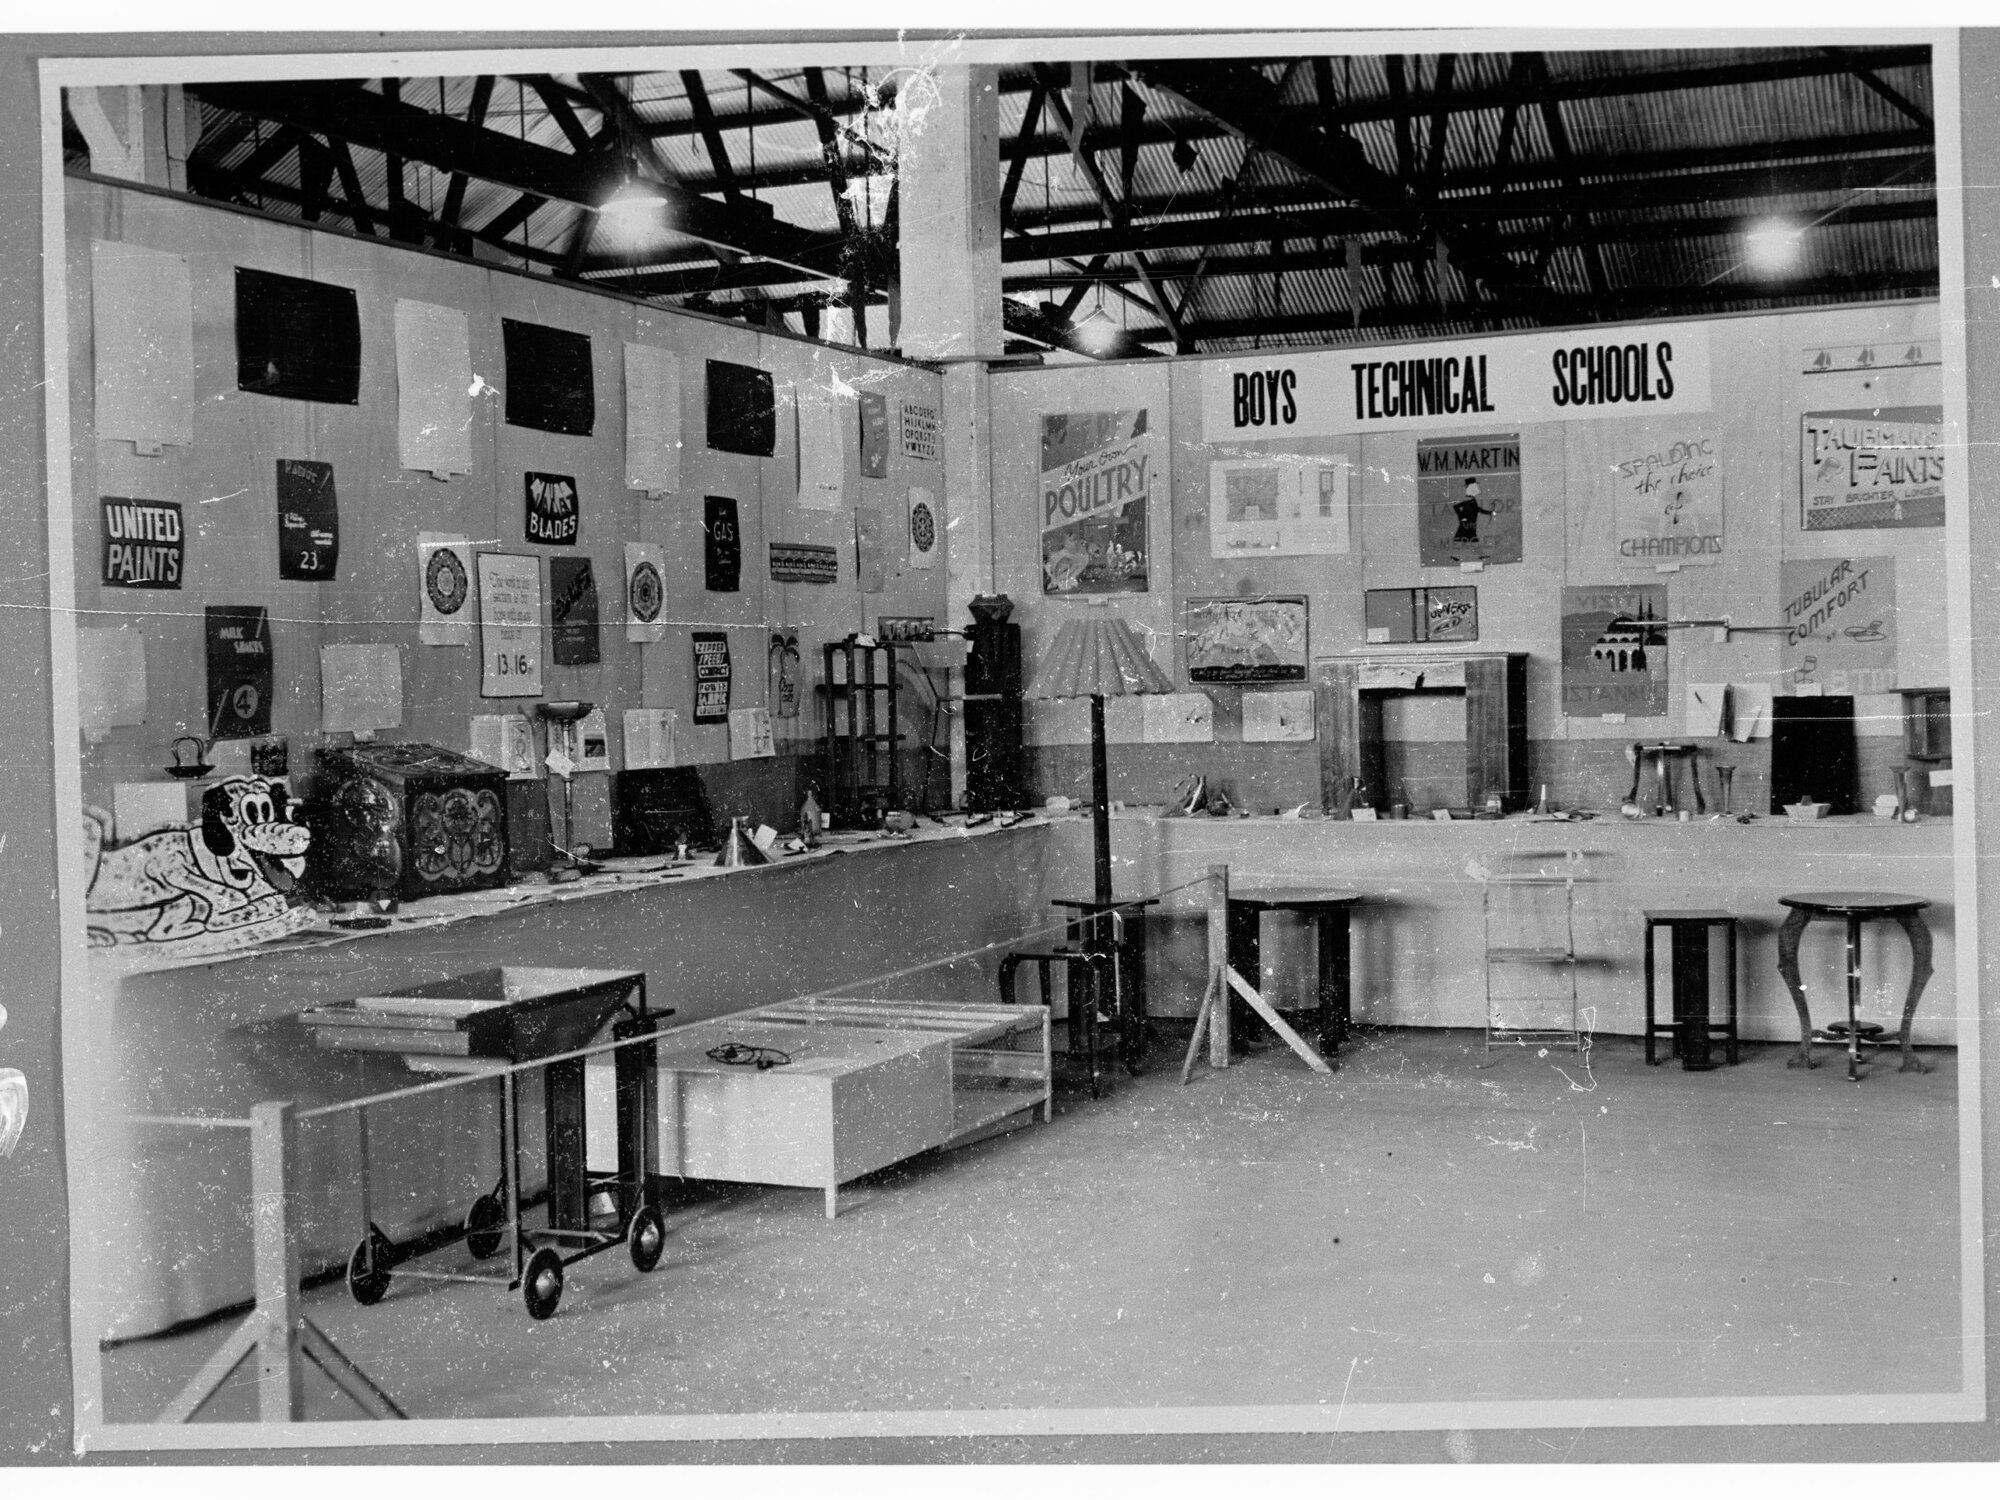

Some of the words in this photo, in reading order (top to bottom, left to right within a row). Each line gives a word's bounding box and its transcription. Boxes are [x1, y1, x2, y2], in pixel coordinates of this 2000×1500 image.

[1233, 369, 1297, 427] BOYS
[1351, 354, 1495, 420] TECHNICAL
[1552, 341, 1674, 407] SCHOOLS
[1454, 446, 1519, 470] MARTIN
[1849, 450, 1944, 487] PAINTS
[1045, 454, 1148, 526] POULTRY
[106, 504, 180, 542] UNITED
[530, 511, 576, 539] BLADES
[714, 521, 733, 541] GAS
[107, 543, 180, 582] PAINTS
[300, 551, 318, 570] 23
[1620, 535, 1722, 557] CHAMPIONS
[1783, 559, 1853, 622] TUBULAR
[1788, 569, 1869, 646] COMFORT
[219, 627, 244, 640] MILK
